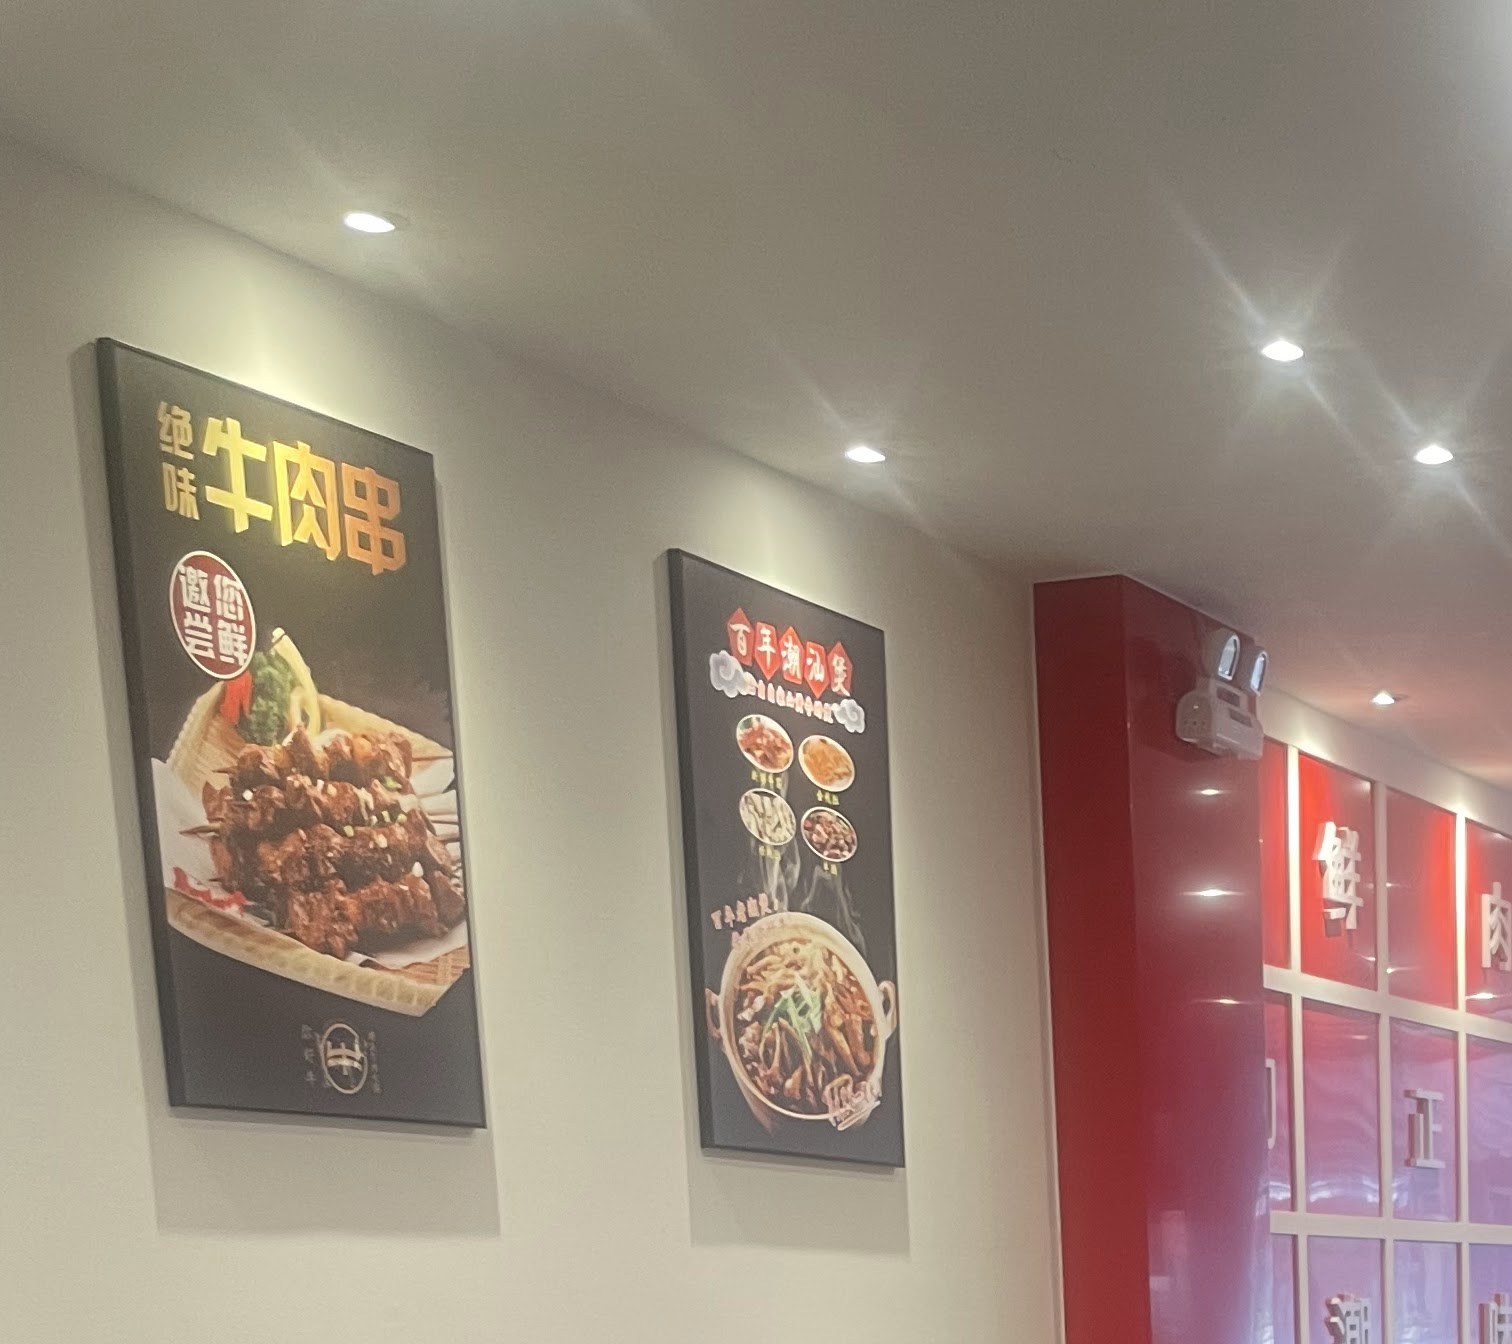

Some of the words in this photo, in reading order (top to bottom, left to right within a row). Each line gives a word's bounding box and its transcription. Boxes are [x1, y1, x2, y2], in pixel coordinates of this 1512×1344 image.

[157, 400, 202, 522] 绝味
[202, 416, 407, 577] 牛肉串
